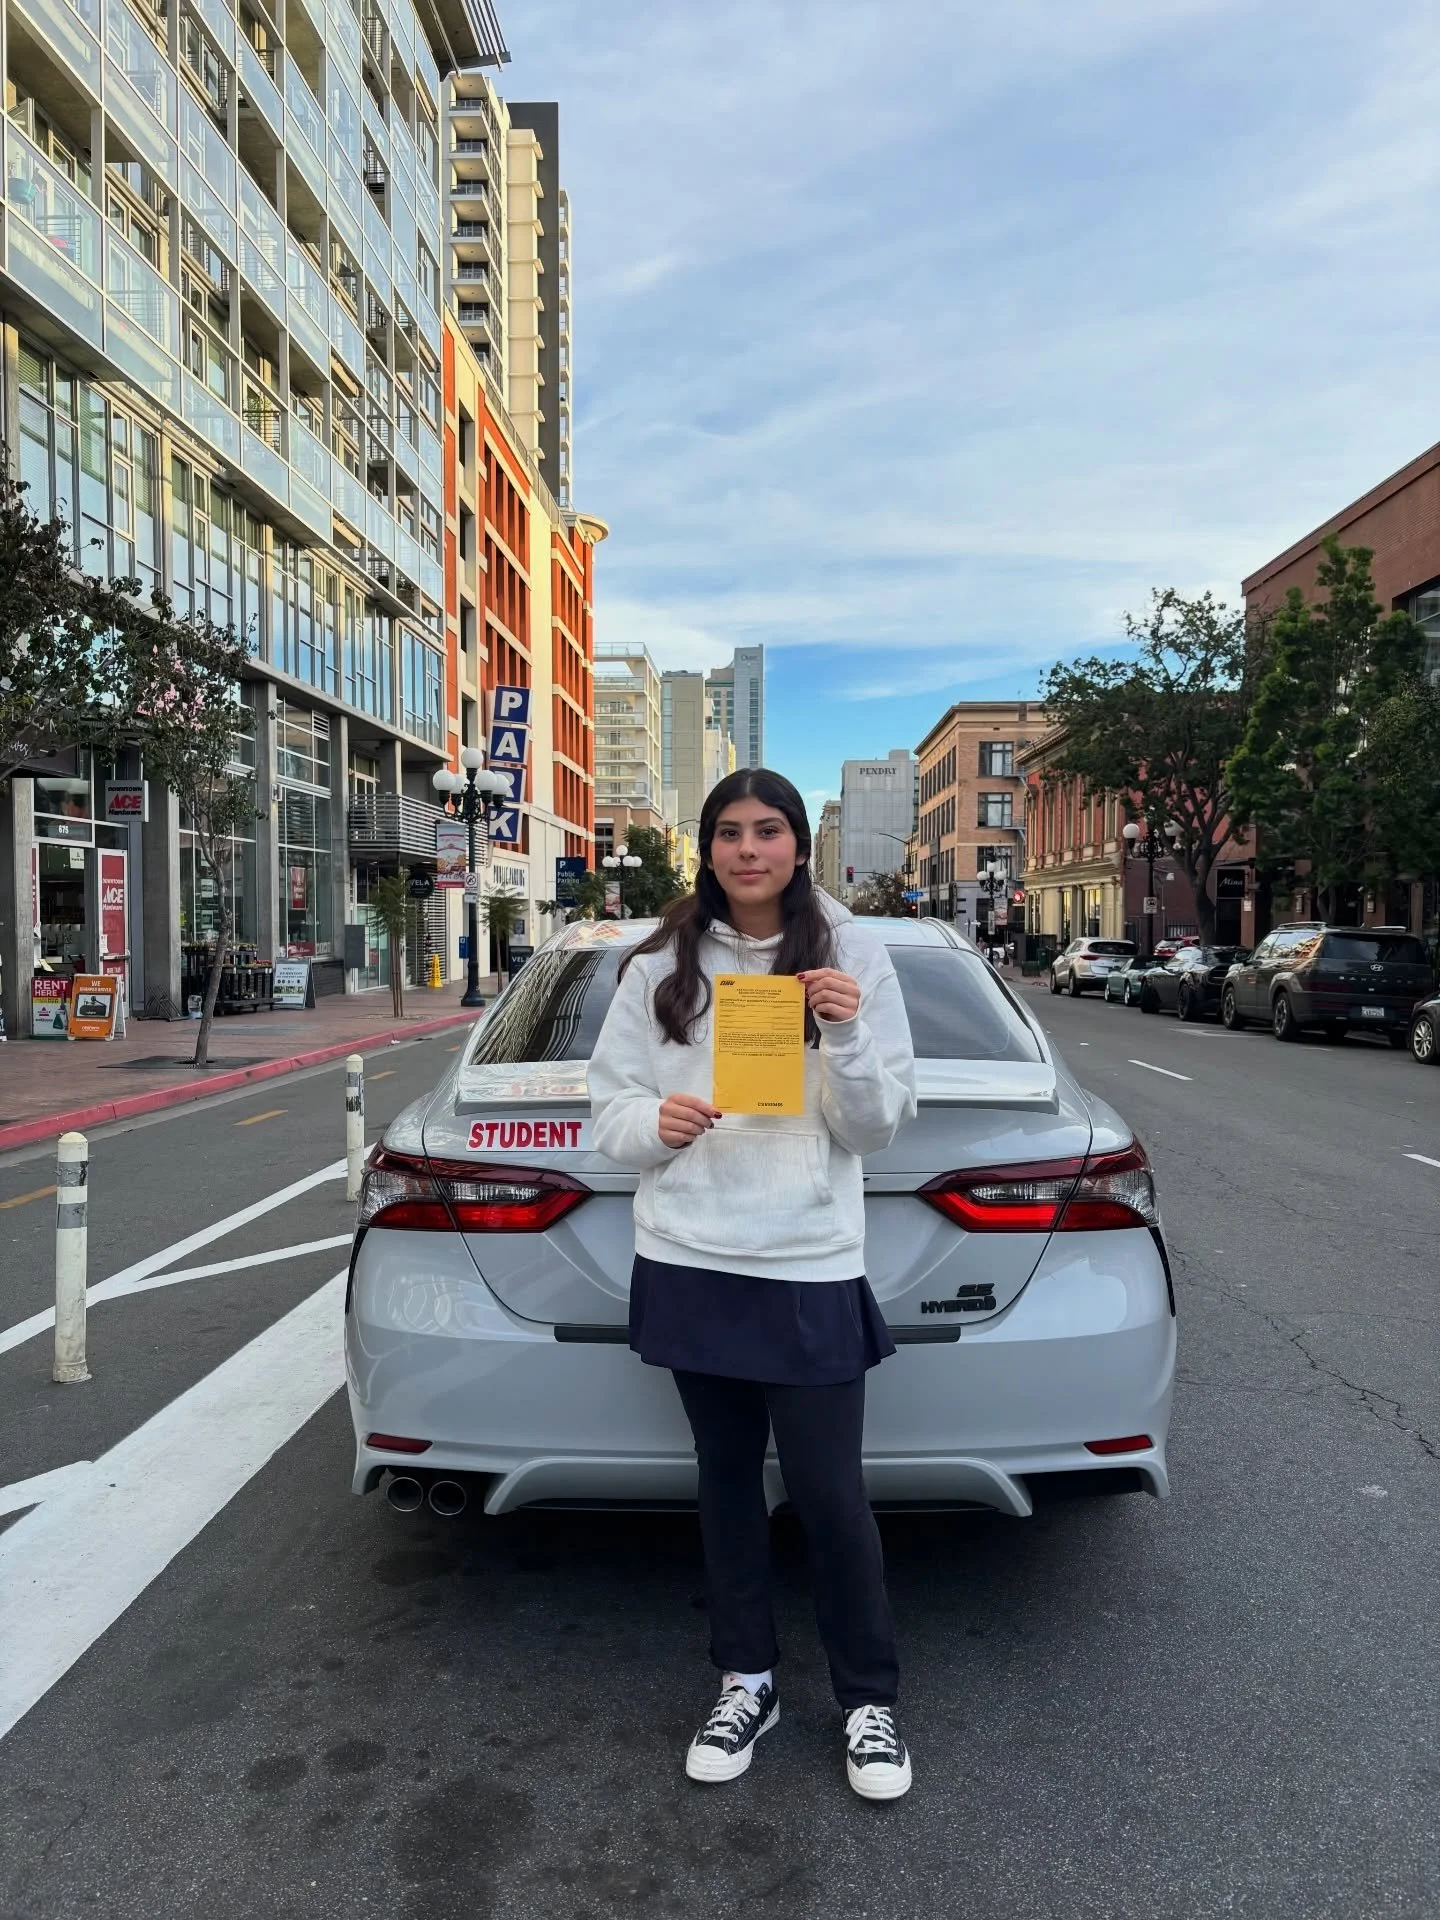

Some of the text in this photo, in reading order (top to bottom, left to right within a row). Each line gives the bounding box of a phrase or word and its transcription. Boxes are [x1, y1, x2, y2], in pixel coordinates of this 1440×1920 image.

[859, 767, 897, 775] PENDRY
[108, 793, 142, 809] ACE
[58, 825, 69, 834] 675
[559, 860, 566, 868] P
[103, 885, 124, 904] ACE
[34, 980, 68, 990] RENT
[468, 1121, 582, 1148] STUDENT
[921, 1296, 996, 1314] HYBRID
